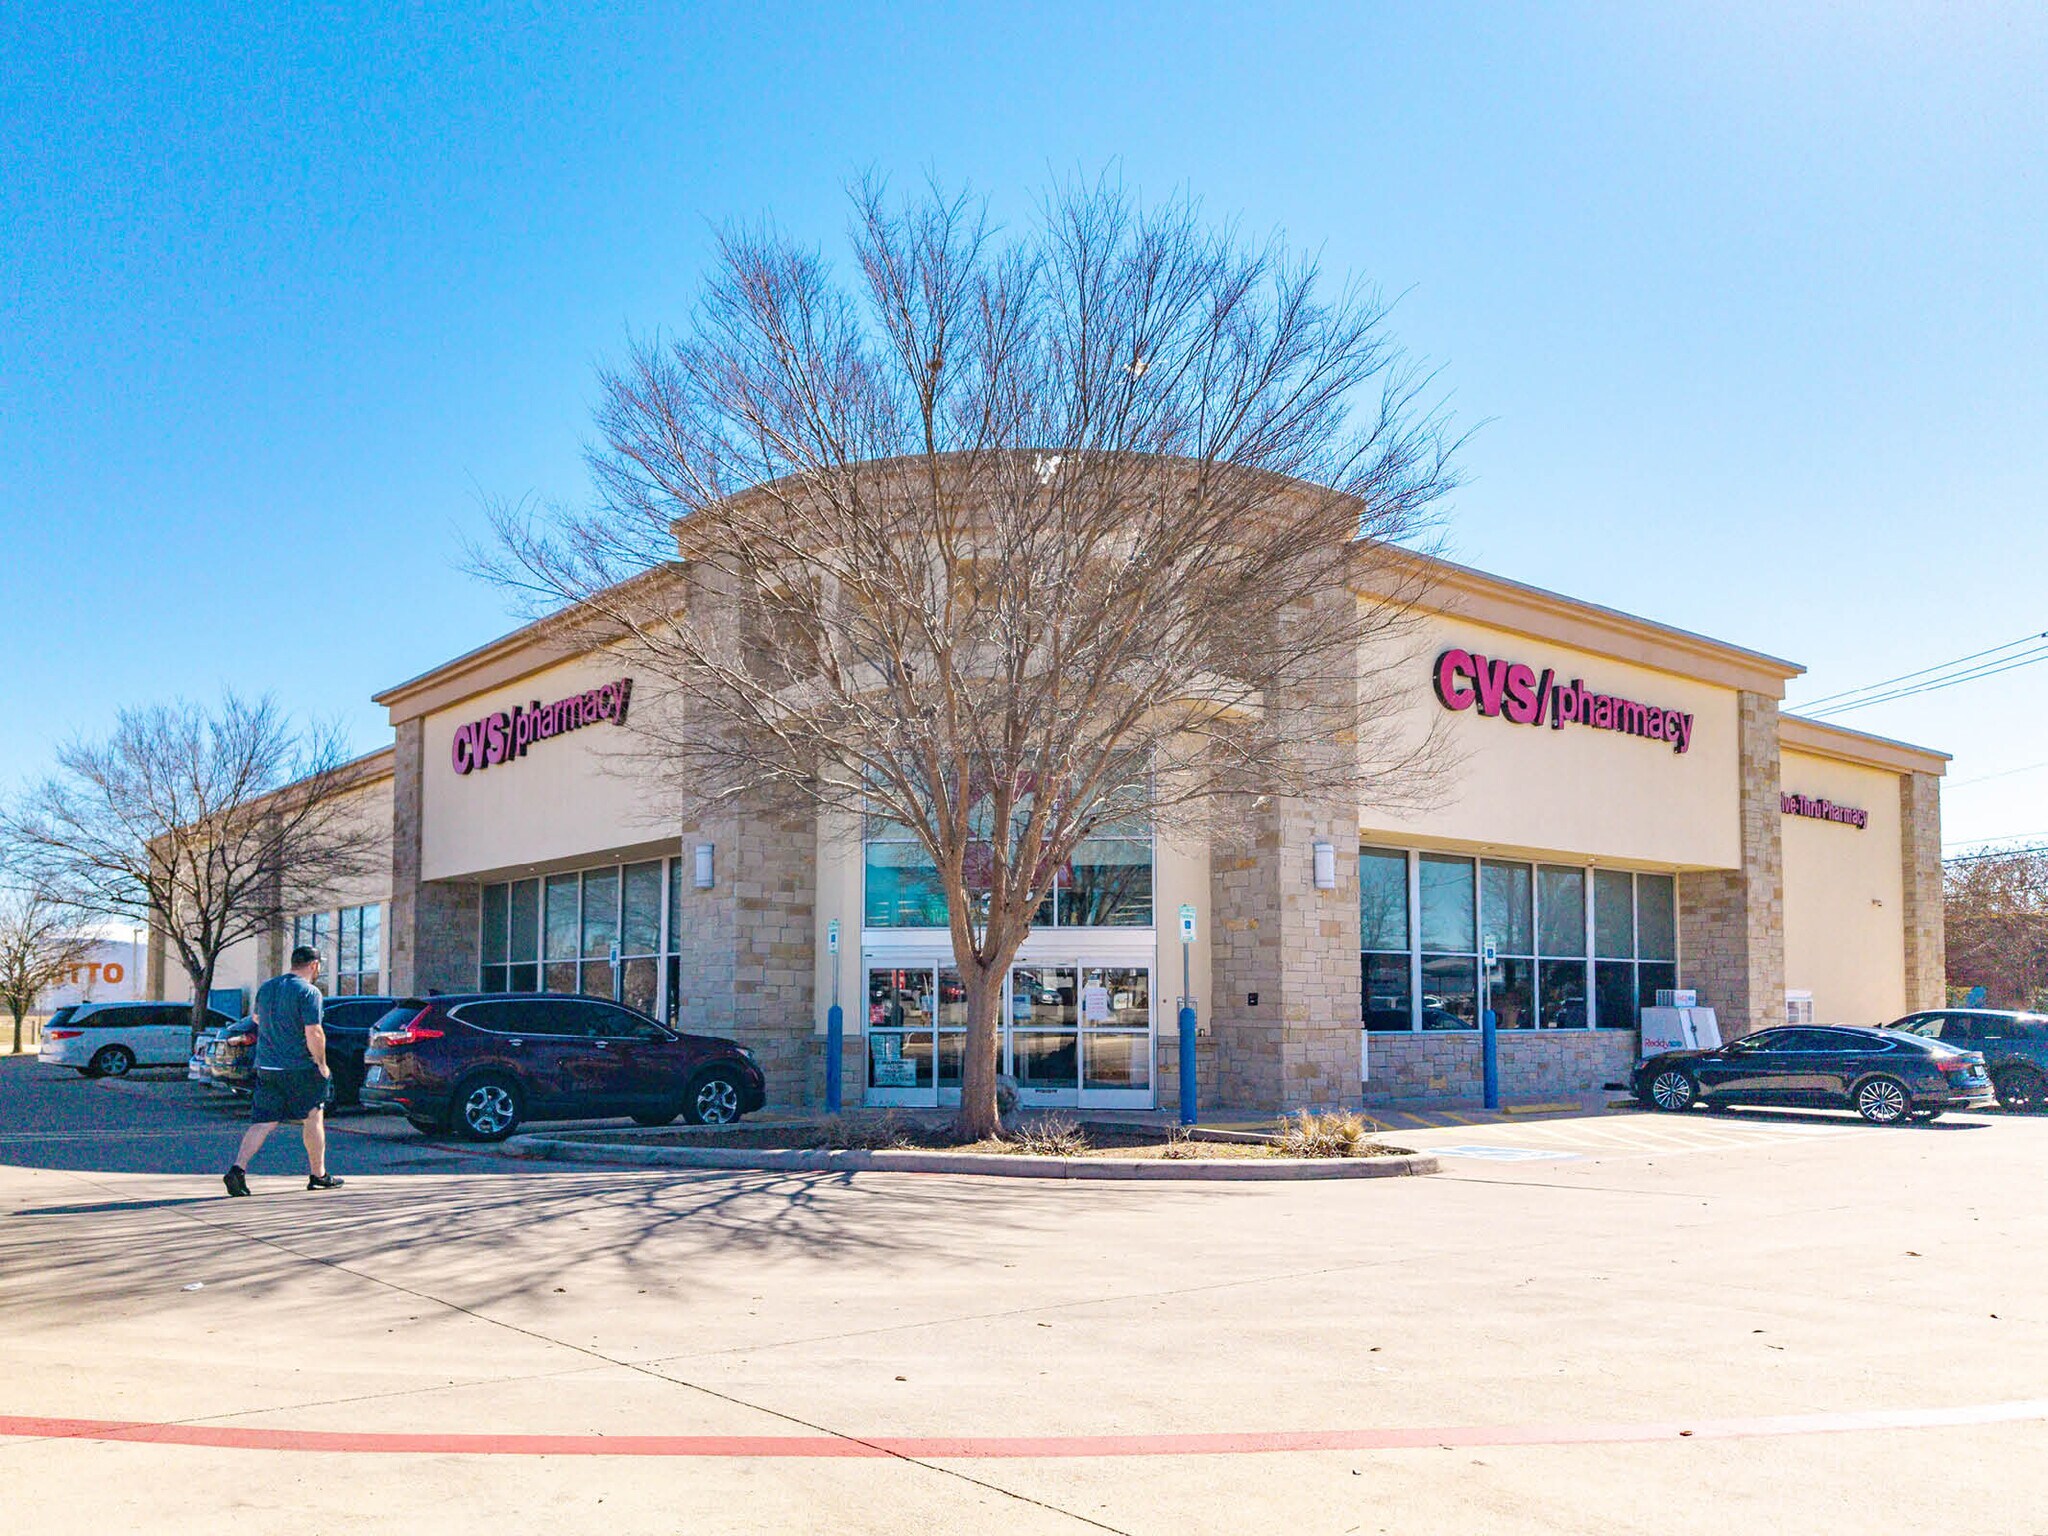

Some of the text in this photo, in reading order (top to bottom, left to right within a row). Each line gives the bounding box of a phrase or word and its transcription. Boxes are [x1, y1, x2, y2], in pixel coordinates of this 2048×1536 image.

[452, 677, 633, 775] CVS/pharmacy
[1432, 648, 1695, 754] CVS/pharmacy
[1780, 791, 1868, 829] ive-Thru Pharmacy
